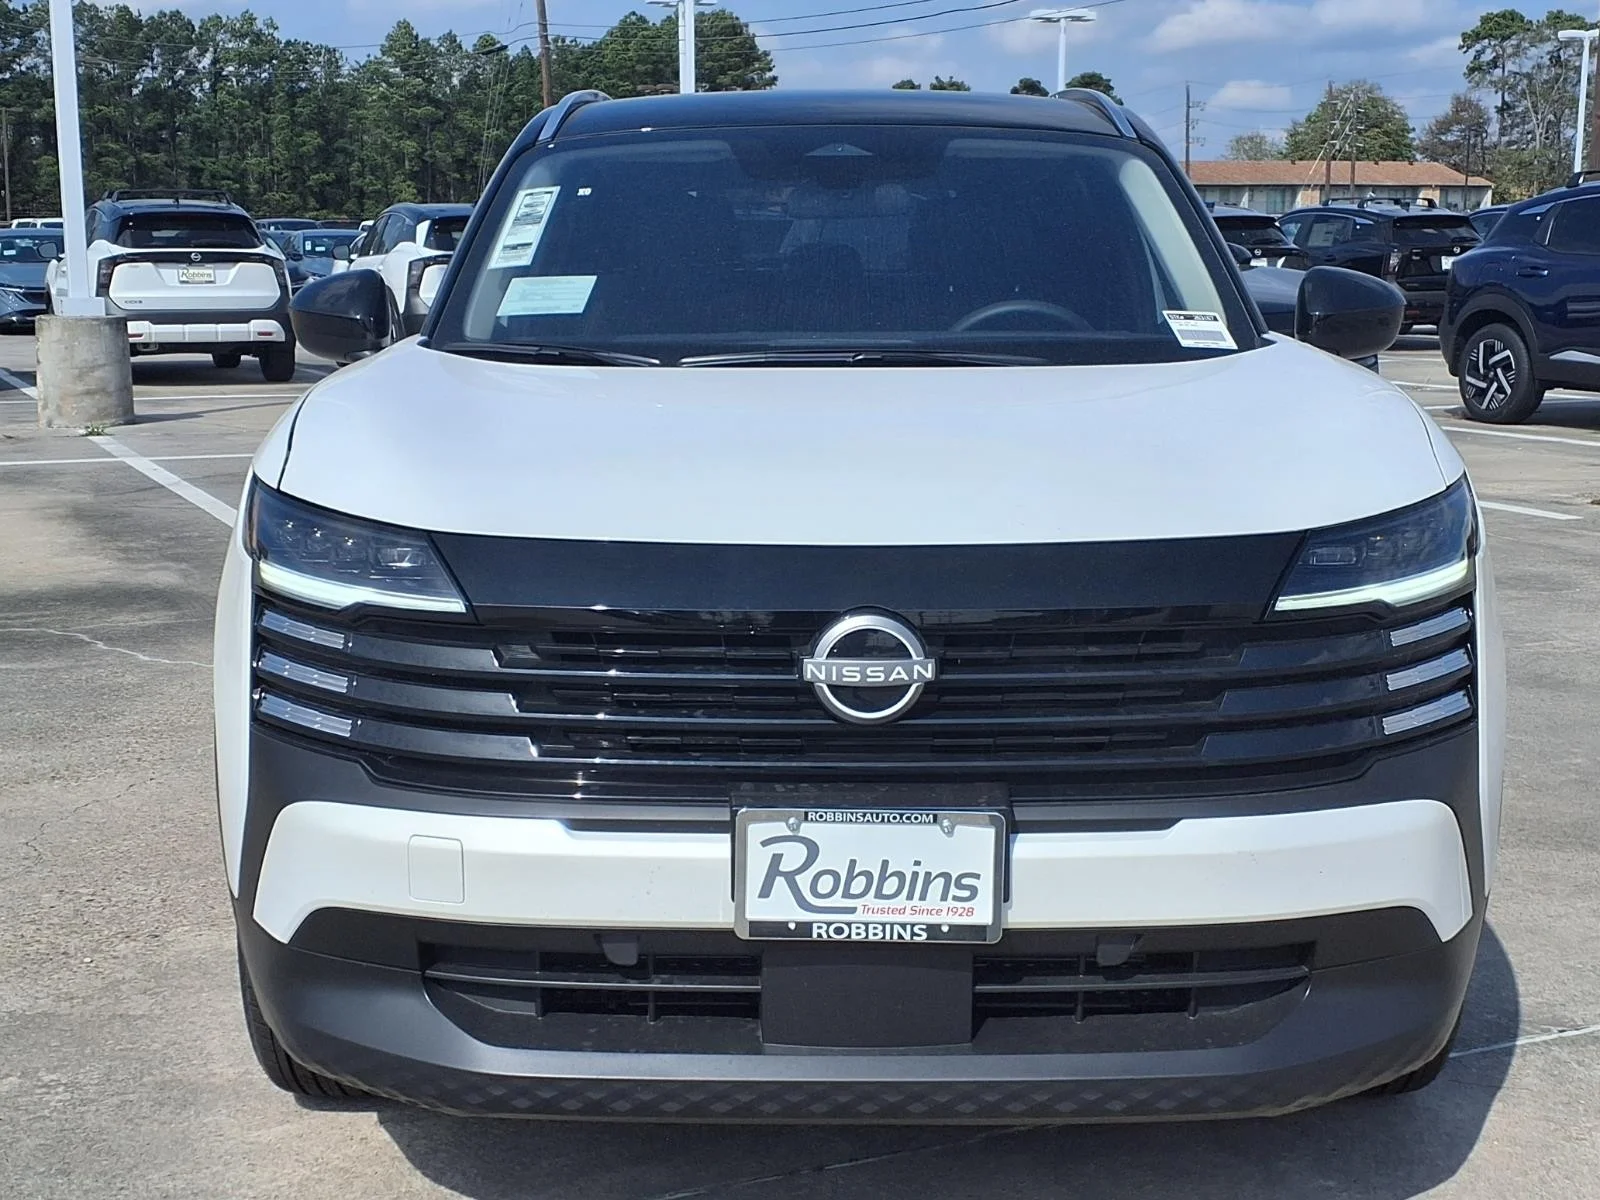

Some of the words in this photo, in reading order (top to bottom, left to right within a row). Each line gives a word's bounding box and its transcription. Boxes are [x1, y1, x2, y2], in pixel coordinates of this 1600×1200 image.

[181, 267, 212, 279] Robbins
[806, 663, 932, 682] NISSAN
[807, 811, 934, 824] ROBBINSAUTO.COM
[757, 834, 982, 915] Robbins
[861, 904, 906, 916] Trusted
[909, 905, 943, 917] Since
[946, 906, 975, 917] 1928
[811, 922, 928, 941] ROBBINS
